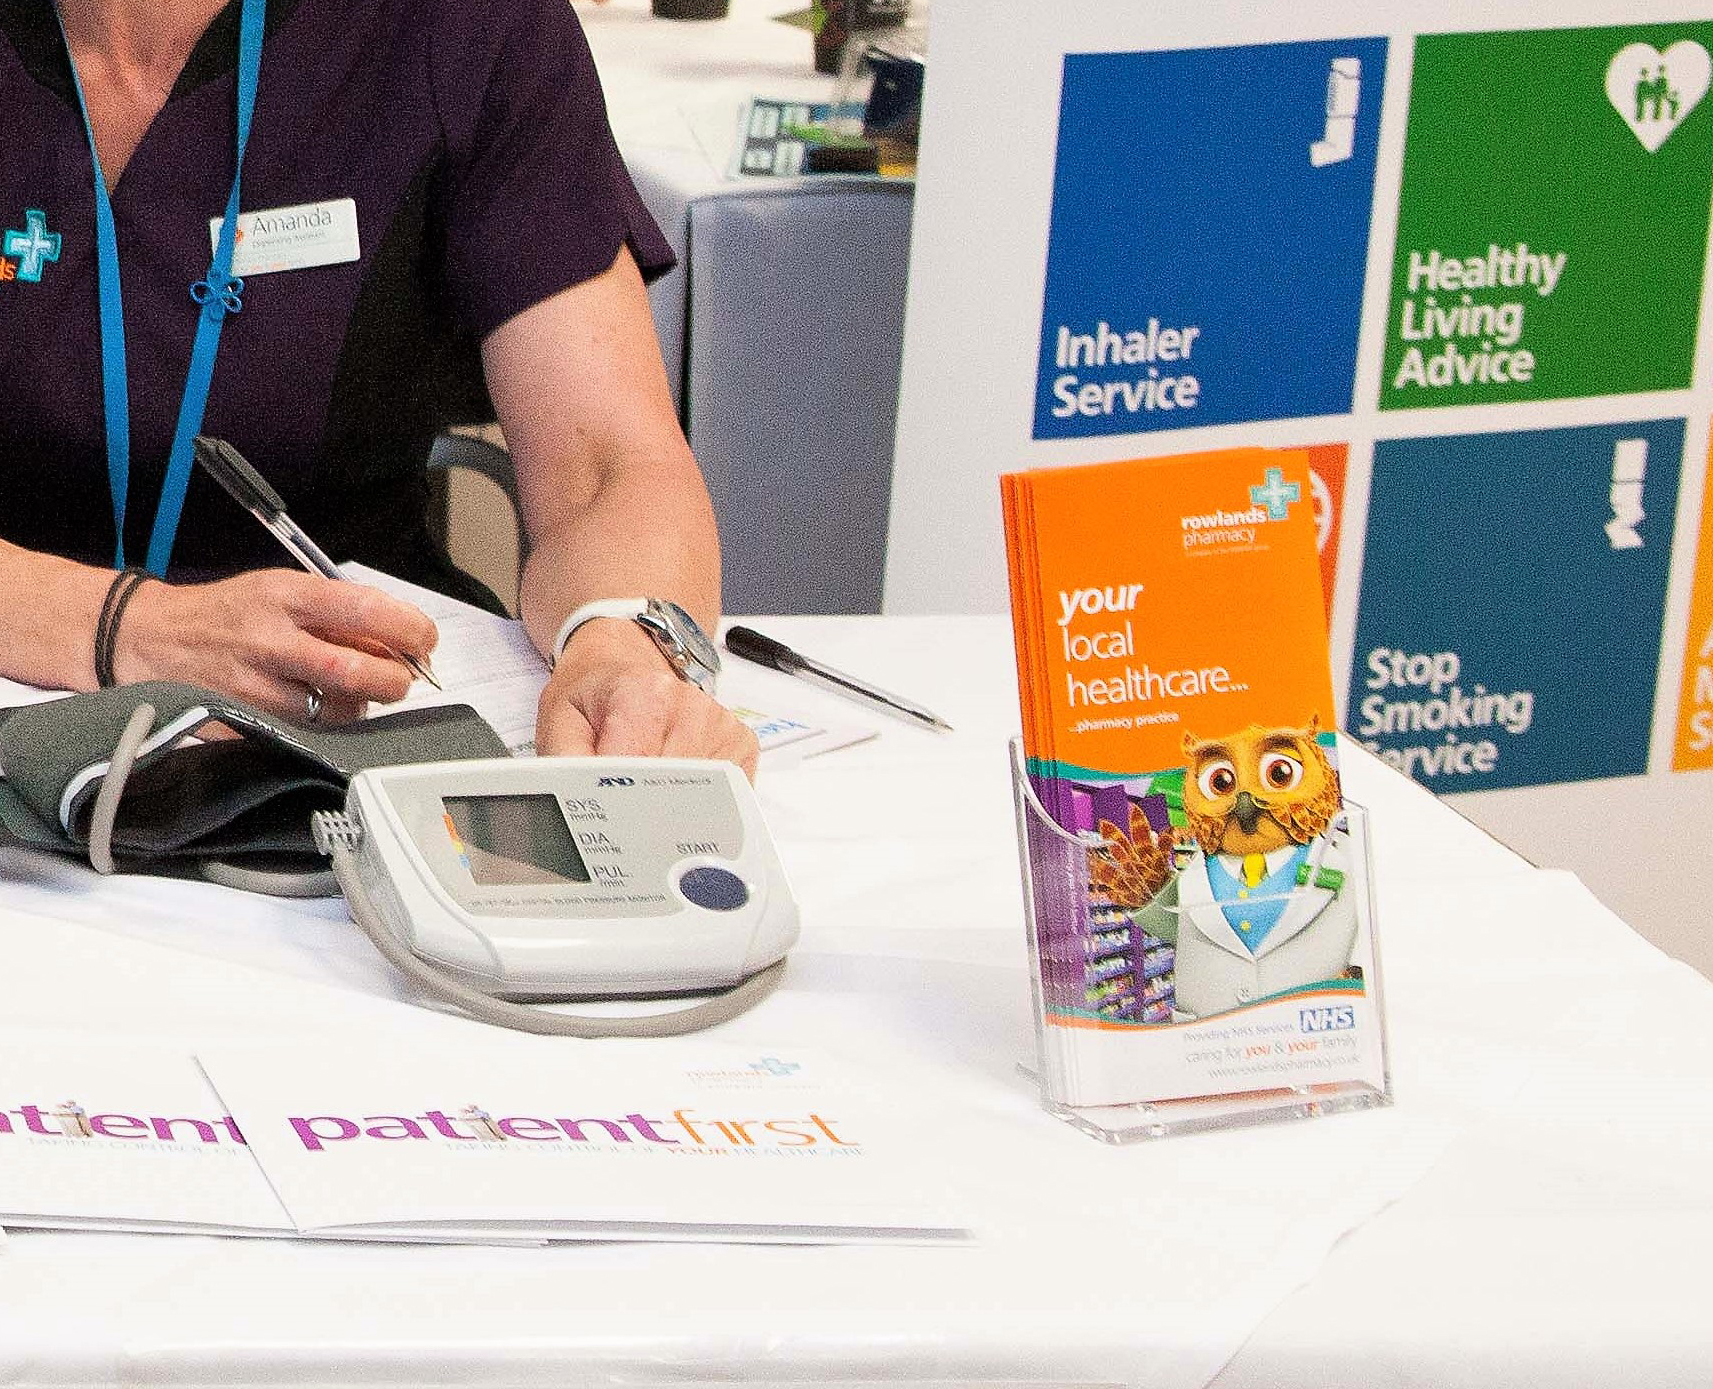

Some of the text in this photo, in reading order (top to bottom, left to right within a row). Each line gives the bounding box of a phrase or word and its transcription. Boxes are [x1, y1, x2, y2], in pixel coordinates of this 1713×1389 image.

[252, 207, 333, 237] Amanda
[1407, 244, 1569, 298] Healthy
[1056, 318, 1201, 369] Inhaler
[1400, 297, 1524, 351] Living
[1394, 342, 1536, 390] Advice
[1051, 367, 1201, 418] Service
[1181, 506, 1268, 530] rowlands
[1182, 527, 1257, 550] pharmacy
[1056, 582, 1144, 626] your
[1061, 621, 1134, 663] local
[1065, 663, 1250, 708] healthcare...
[1365, 646, 1462, 695] Stop
[1136, 710, 1181, 729] practice
[1359, 683, 1535, 735] Smoking
[676, 842, 721, 856] START
[1300, 1006, 1356, 1034] NHS
[1243, 1044, 1272, 1059] you
[1286, 1040, 1320, 1056] your
